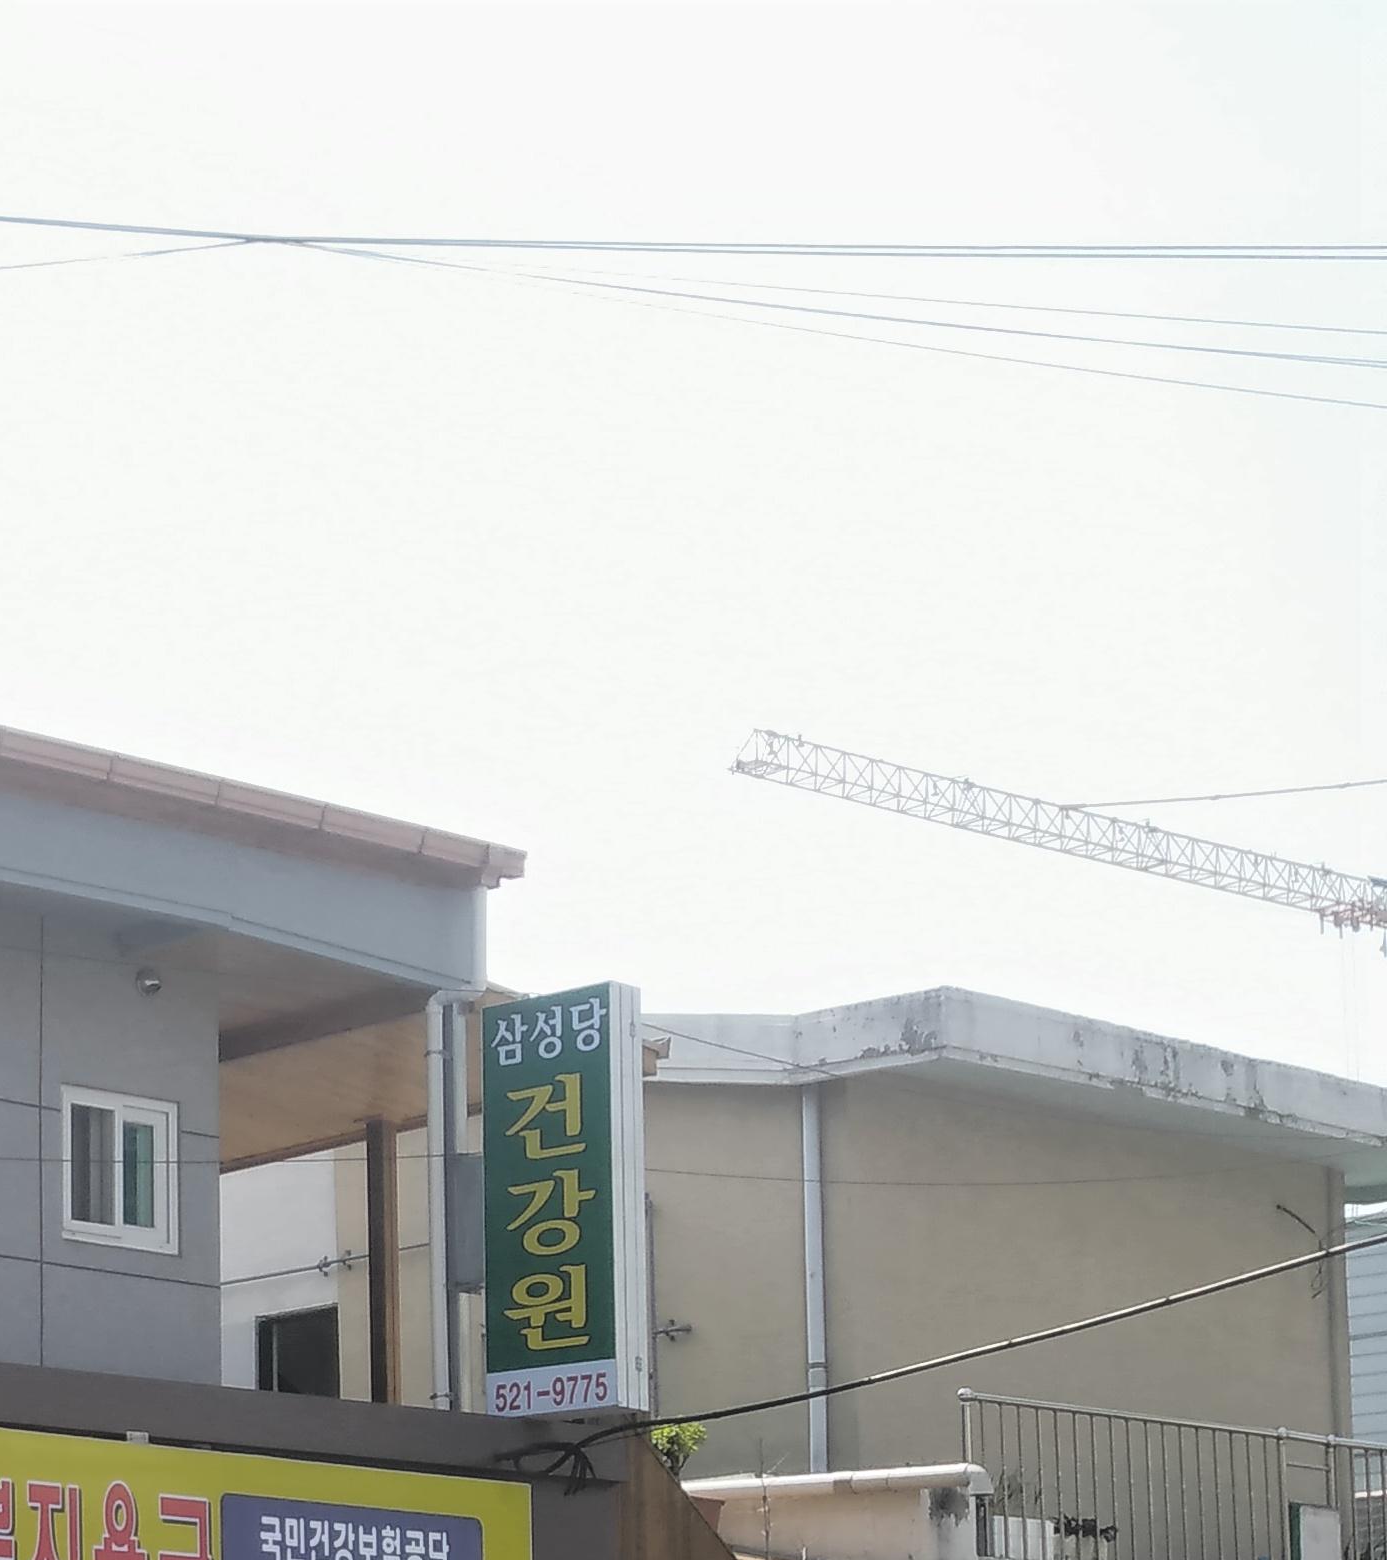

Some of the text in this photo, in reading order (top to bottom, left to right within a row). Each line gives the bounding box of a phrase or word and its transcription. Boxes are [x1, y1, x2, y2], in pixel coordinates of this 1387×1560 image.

[490, 997, 608, 1067] 삼성당
[502, 1071, 597, 1353] 건강원
[494, 1370, 609, 1413] 521-9775
